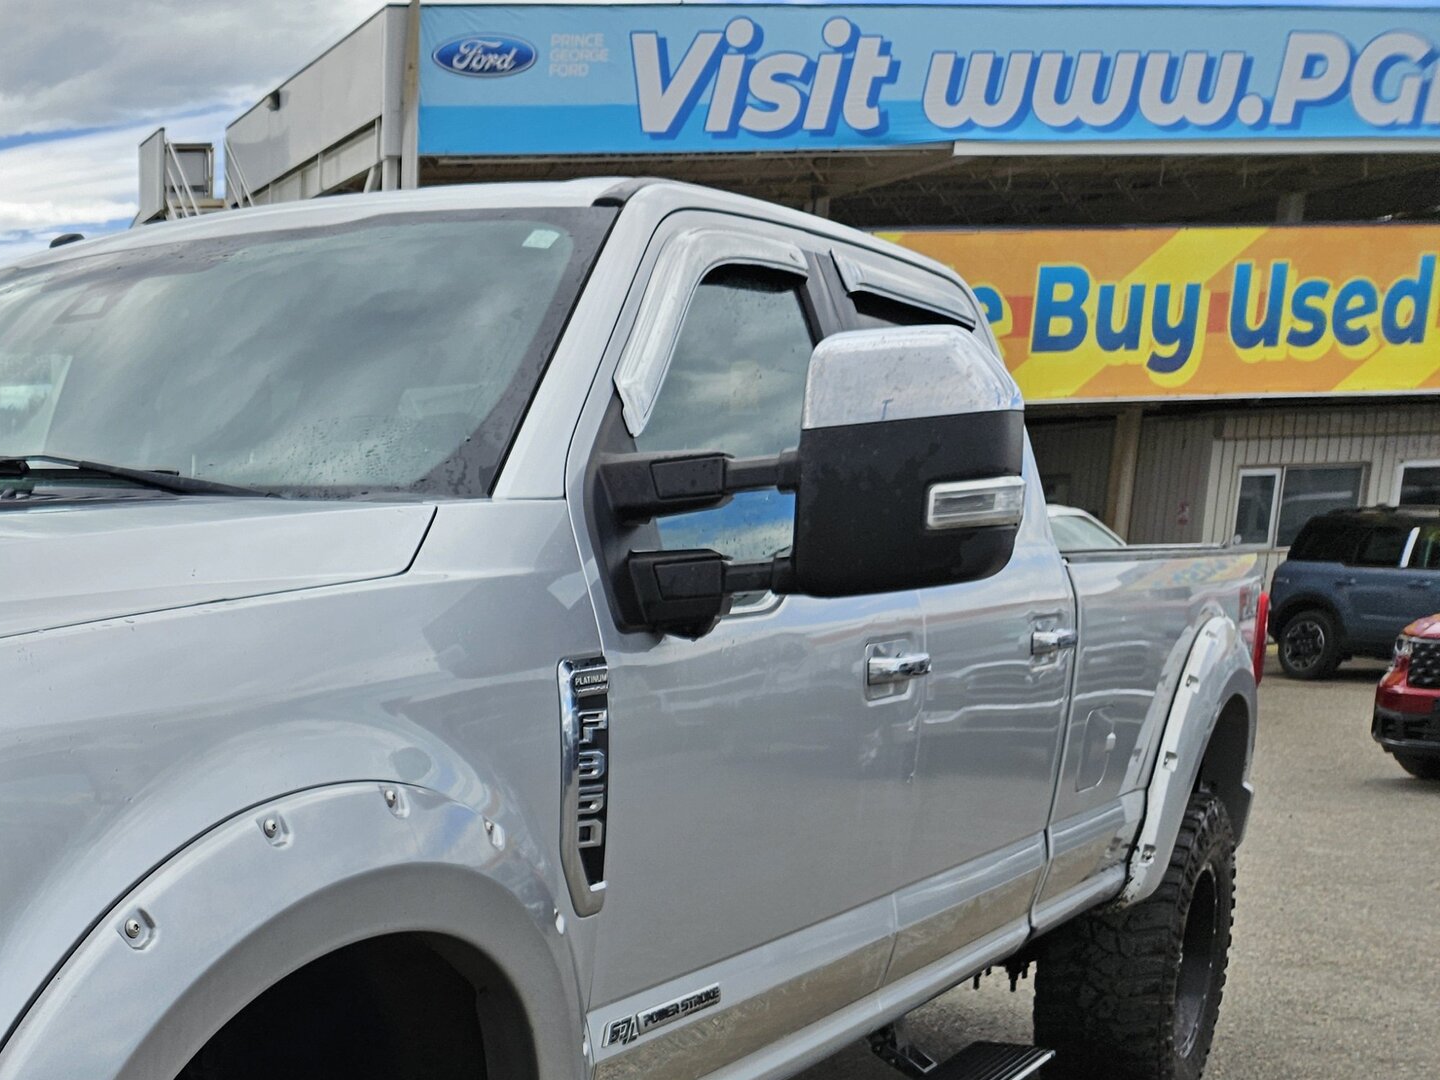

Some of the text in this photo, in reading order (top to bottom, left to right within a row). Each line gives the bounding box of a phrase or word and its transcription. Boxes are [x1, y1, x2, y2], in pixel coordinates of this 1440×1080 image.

[550, 33, 605, 47] PRINCE
[452, 38, 518, 72] Ford
[549, 48, 609, 62] GEORGE
[548, 63, 589, 77] FORD
[629, 17, 1440, 134] Visit www.PG
[1030, 253, 1438, 374] Buy Used
[574, 672, 608, 686] PLATINUM
[643, 1003, 679, 1027] POWER
[681, 986, 720, 1012] STROKE
